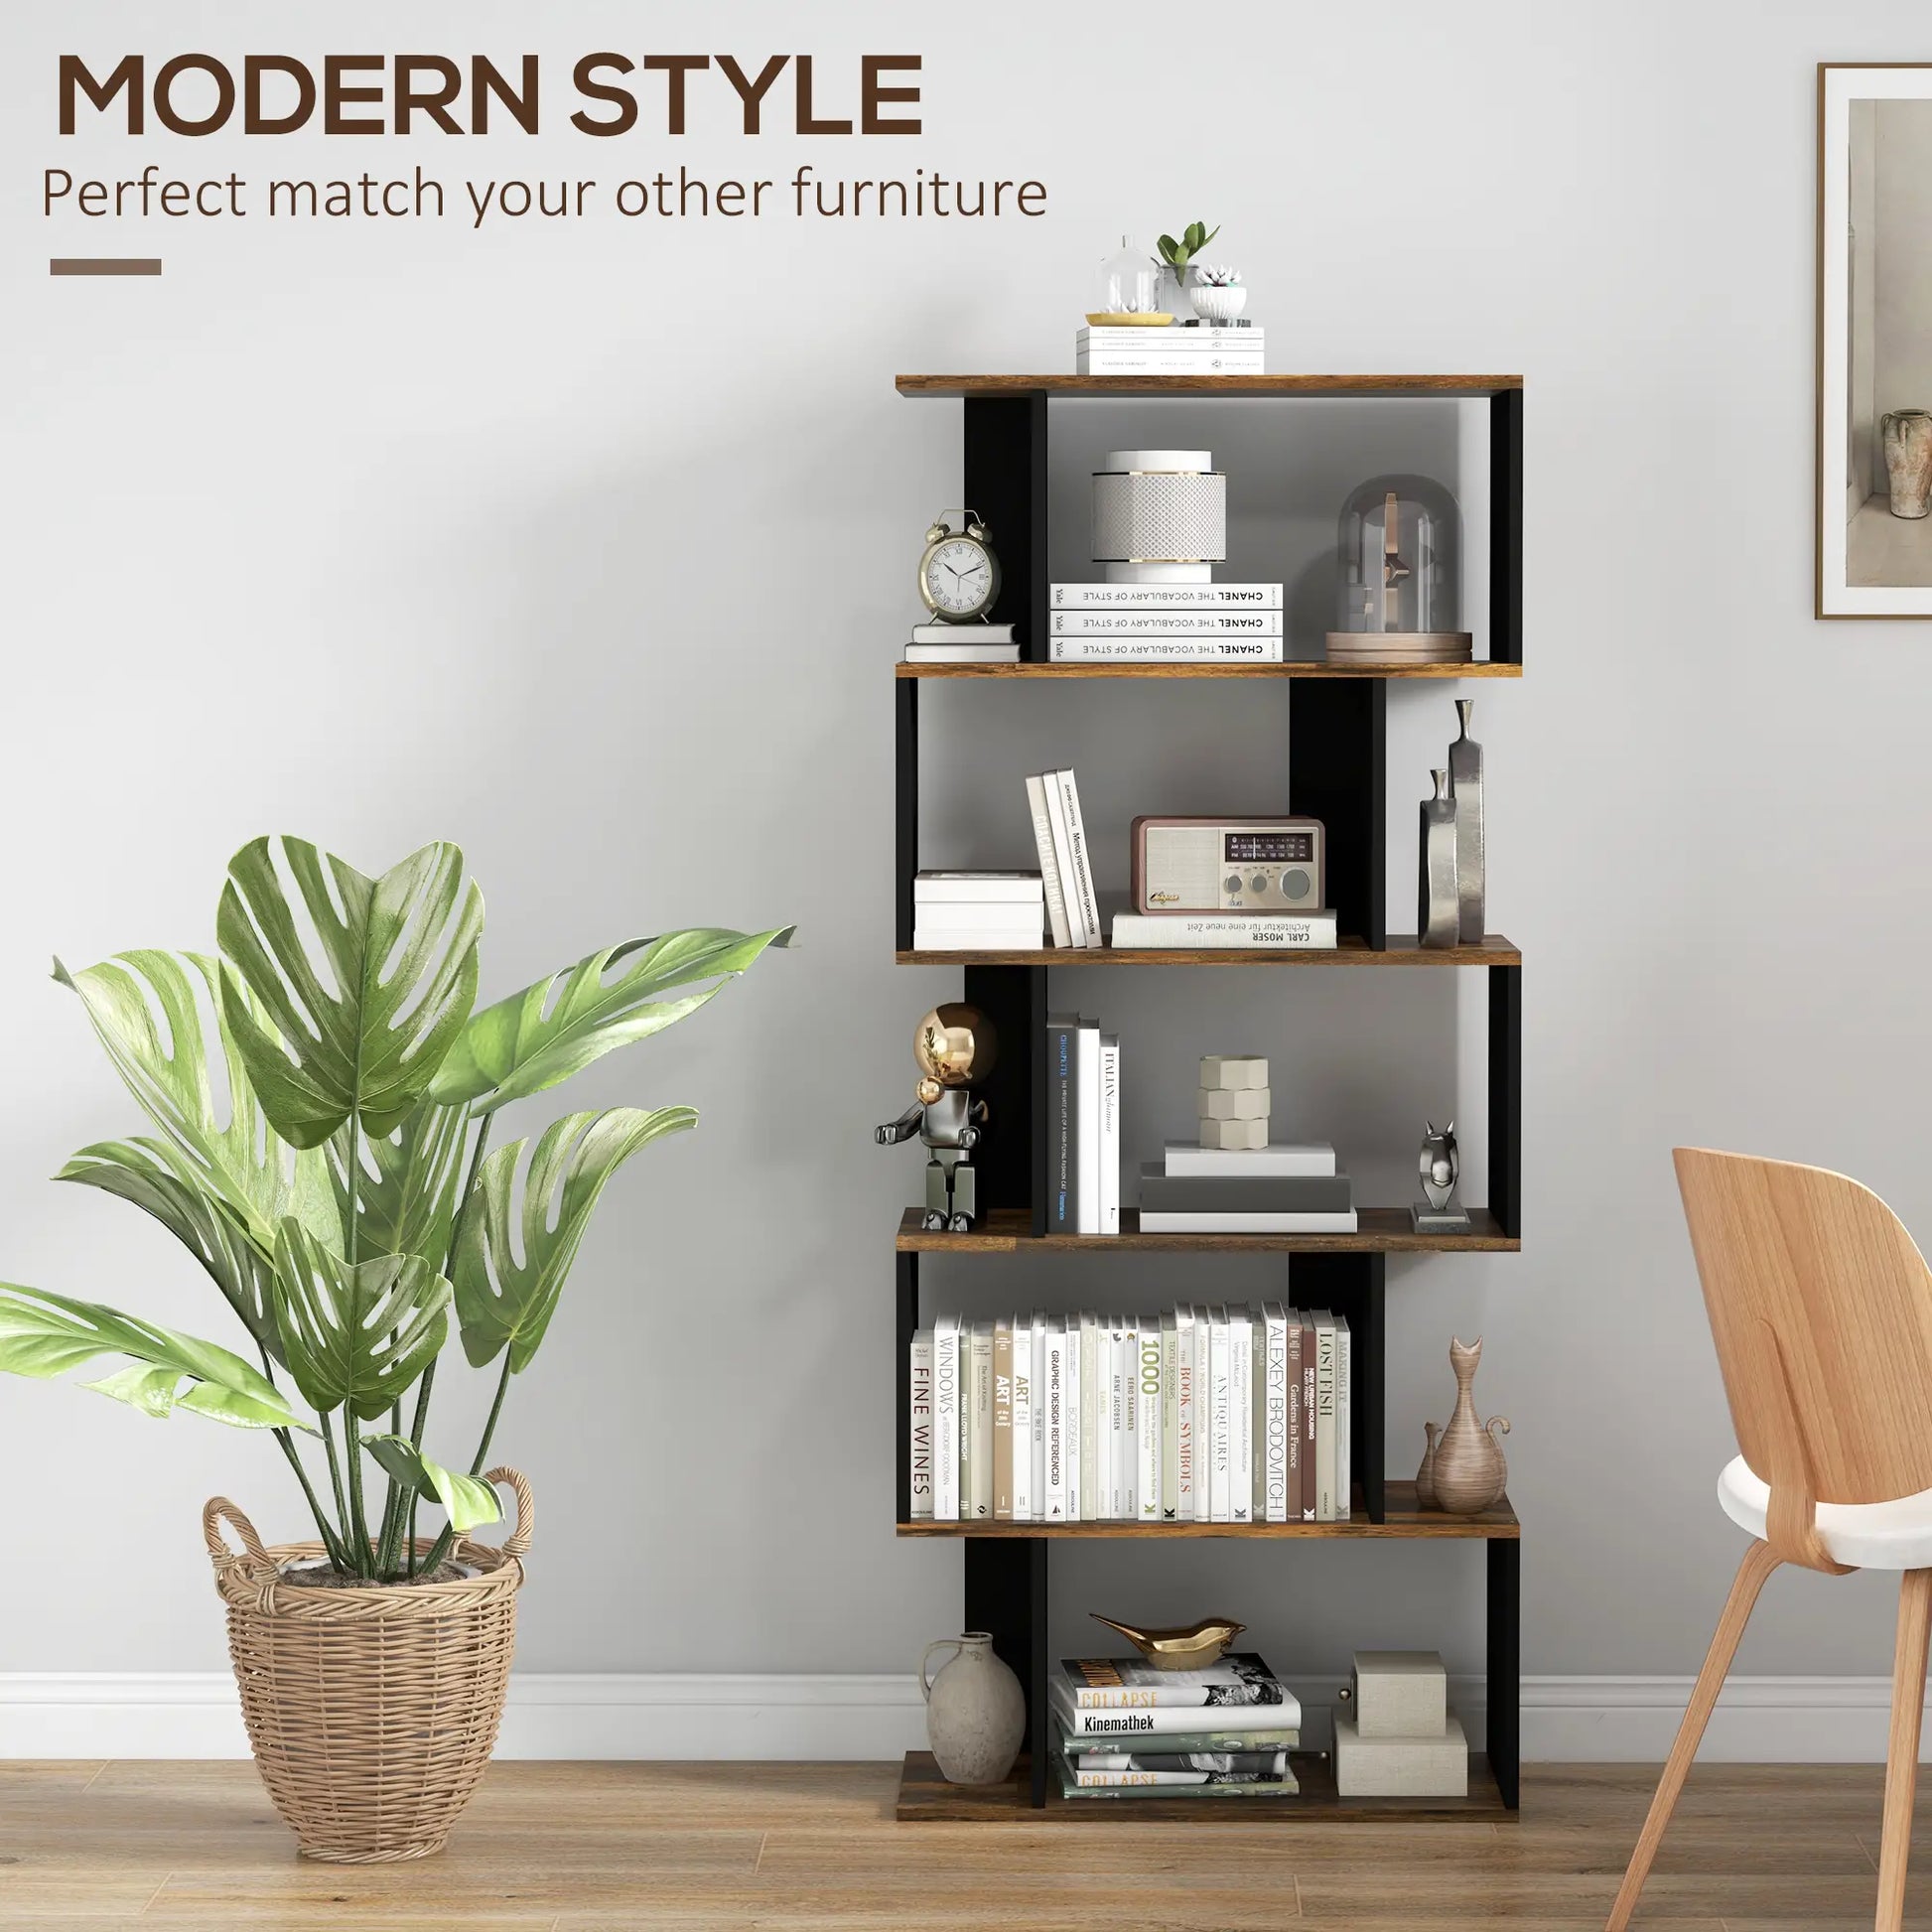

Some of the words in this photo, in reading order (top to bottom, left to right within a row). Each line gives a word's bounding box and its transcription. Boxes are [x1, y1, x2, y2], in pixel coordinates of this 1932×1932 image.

[939, 1337, 953, 1413] WINDOWS
[1142, 1340, 1160, 1395] 1000
[1269, 1325, 1284, 1392] ALEXEY
[1319, 1333, 1332, 1376] LOST
[914, 1368, 928, 1414] FINE
[997, 1375, 1010, 1405] ART
[1017, 1376, 1029, 1405] ART
[1180, 1367, 1191, 1407] BOOK
[1290, 1384, 1299, 1423] Gardens
[1319, 1380, 1331, 1416] FISH
[1068, 1407, 1077, 1456] BORDEAUX
[1216, 1375, 1226, 1471] ANTIQUAIRES
[1290, 1425, 1299, 1435] in
[914, 1425, 929, 1494] WINES
[1180, 1423, 1191, 1492] SYMBOLS
[1269, 1398, 1284, 1508] BRODOVITCH
[1290, 1437, 1299, 1468] France
[1082, 1692, 1158, 1708] COLLAPSE
[1085, 1716, 1154, 1731] Kinemathek
